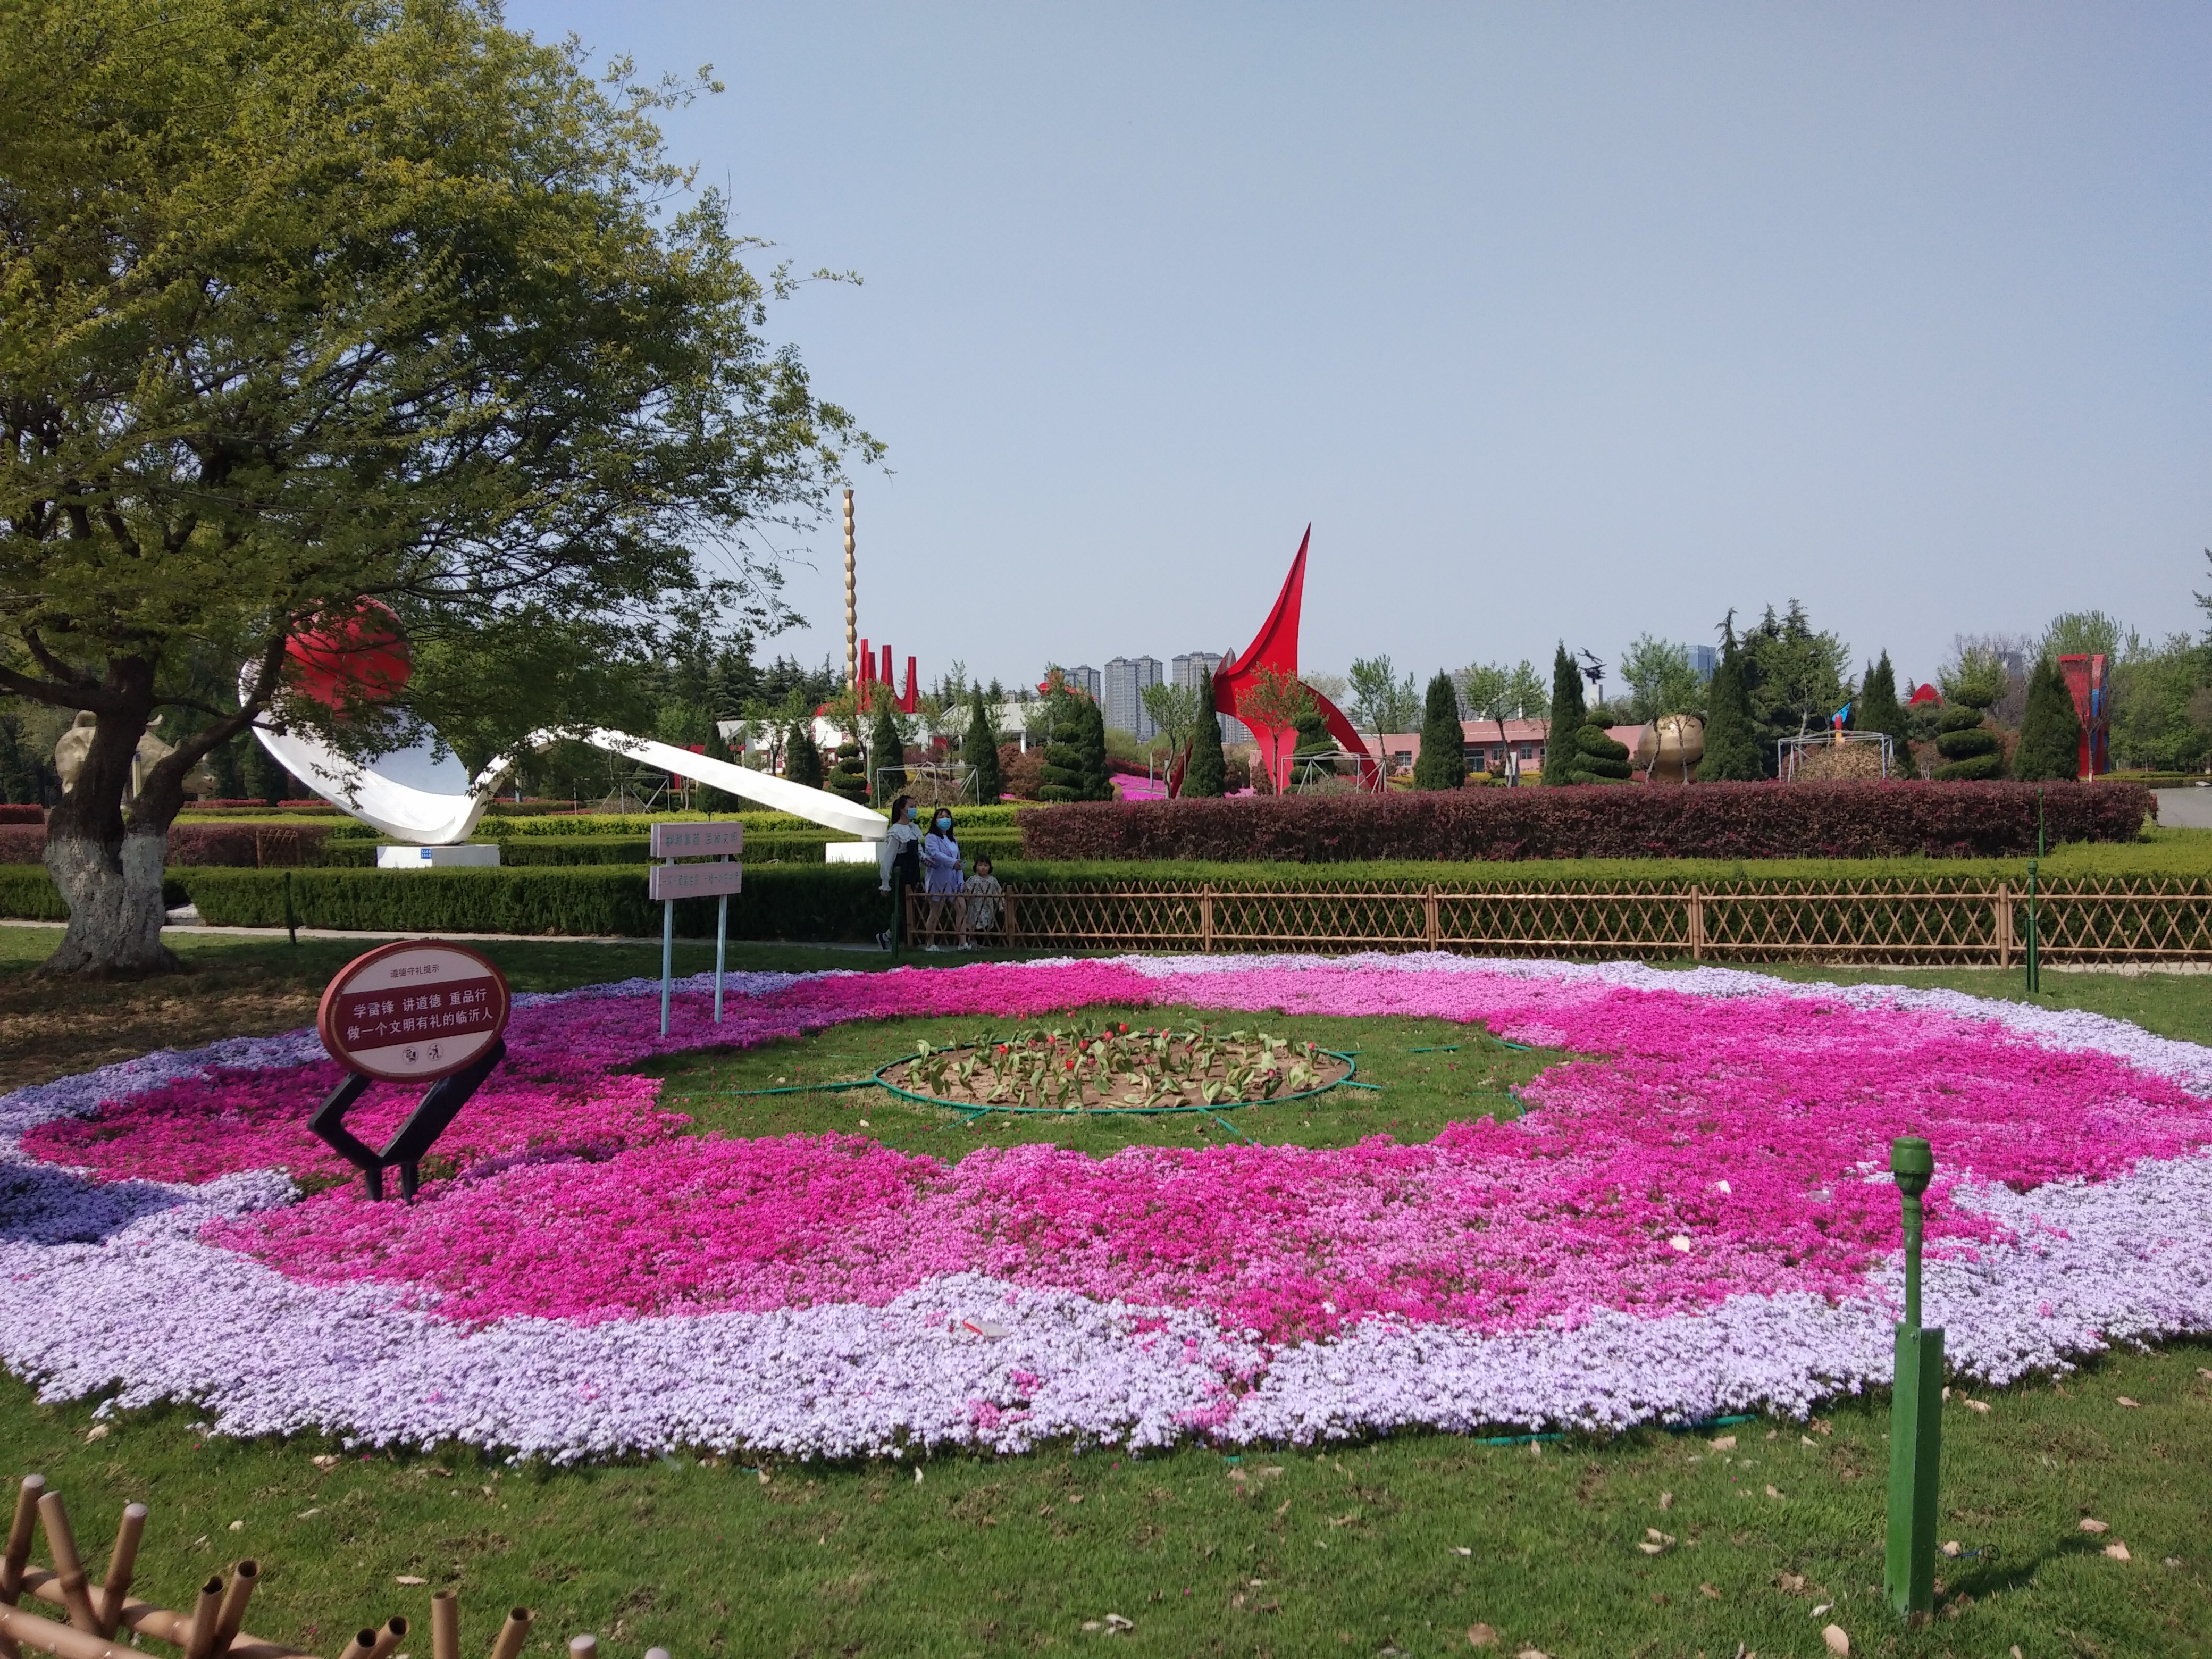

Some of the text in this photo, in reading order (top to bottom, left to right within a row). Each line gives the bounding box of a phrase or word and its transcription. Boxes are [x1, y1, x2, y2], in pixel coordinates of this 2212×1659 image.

[390, 964, 440, 978] 道德守礼提示
[353, 988, 487, 1019] 学雷锋 讲道德 重品行
[347, 1007, 494, 1041] 做一个文明有礼的临沂人
